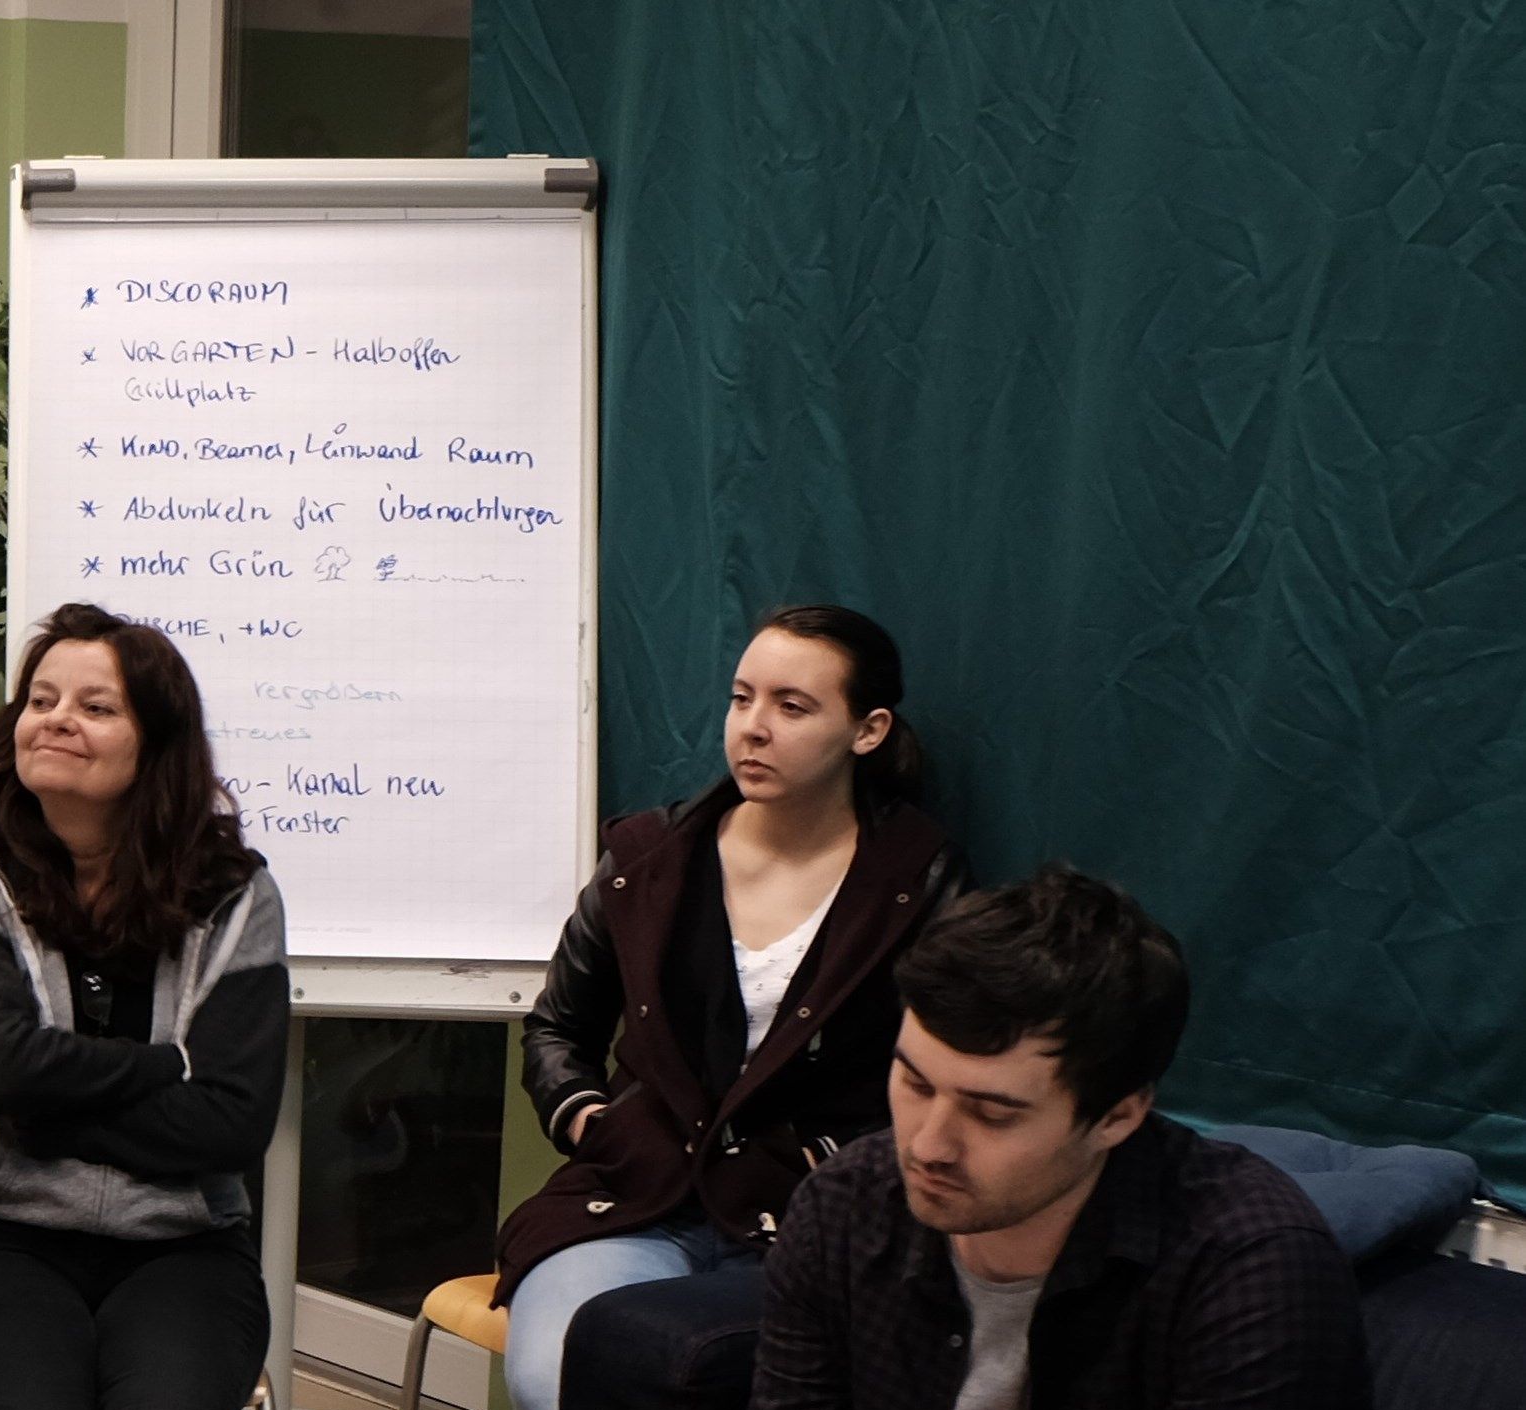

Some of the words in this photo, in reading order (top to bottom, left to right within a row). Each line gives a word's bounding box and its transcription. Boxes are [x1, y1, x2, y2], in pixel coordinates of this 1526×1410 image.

[125, 376, 256, 407] Grillplatz
[448, 436, 533, 469] Raum
[123, 496, 272, 522] Abdunkeln
[293, 496, 346, 530] für
[121, 550, 190, 576] mehr
[210, 550, 293, 578] Grün
[287, 763, 371, 796] Kanal
[387, 772, 446, 797] neu
[258, 805, 350, 835] Fenster
